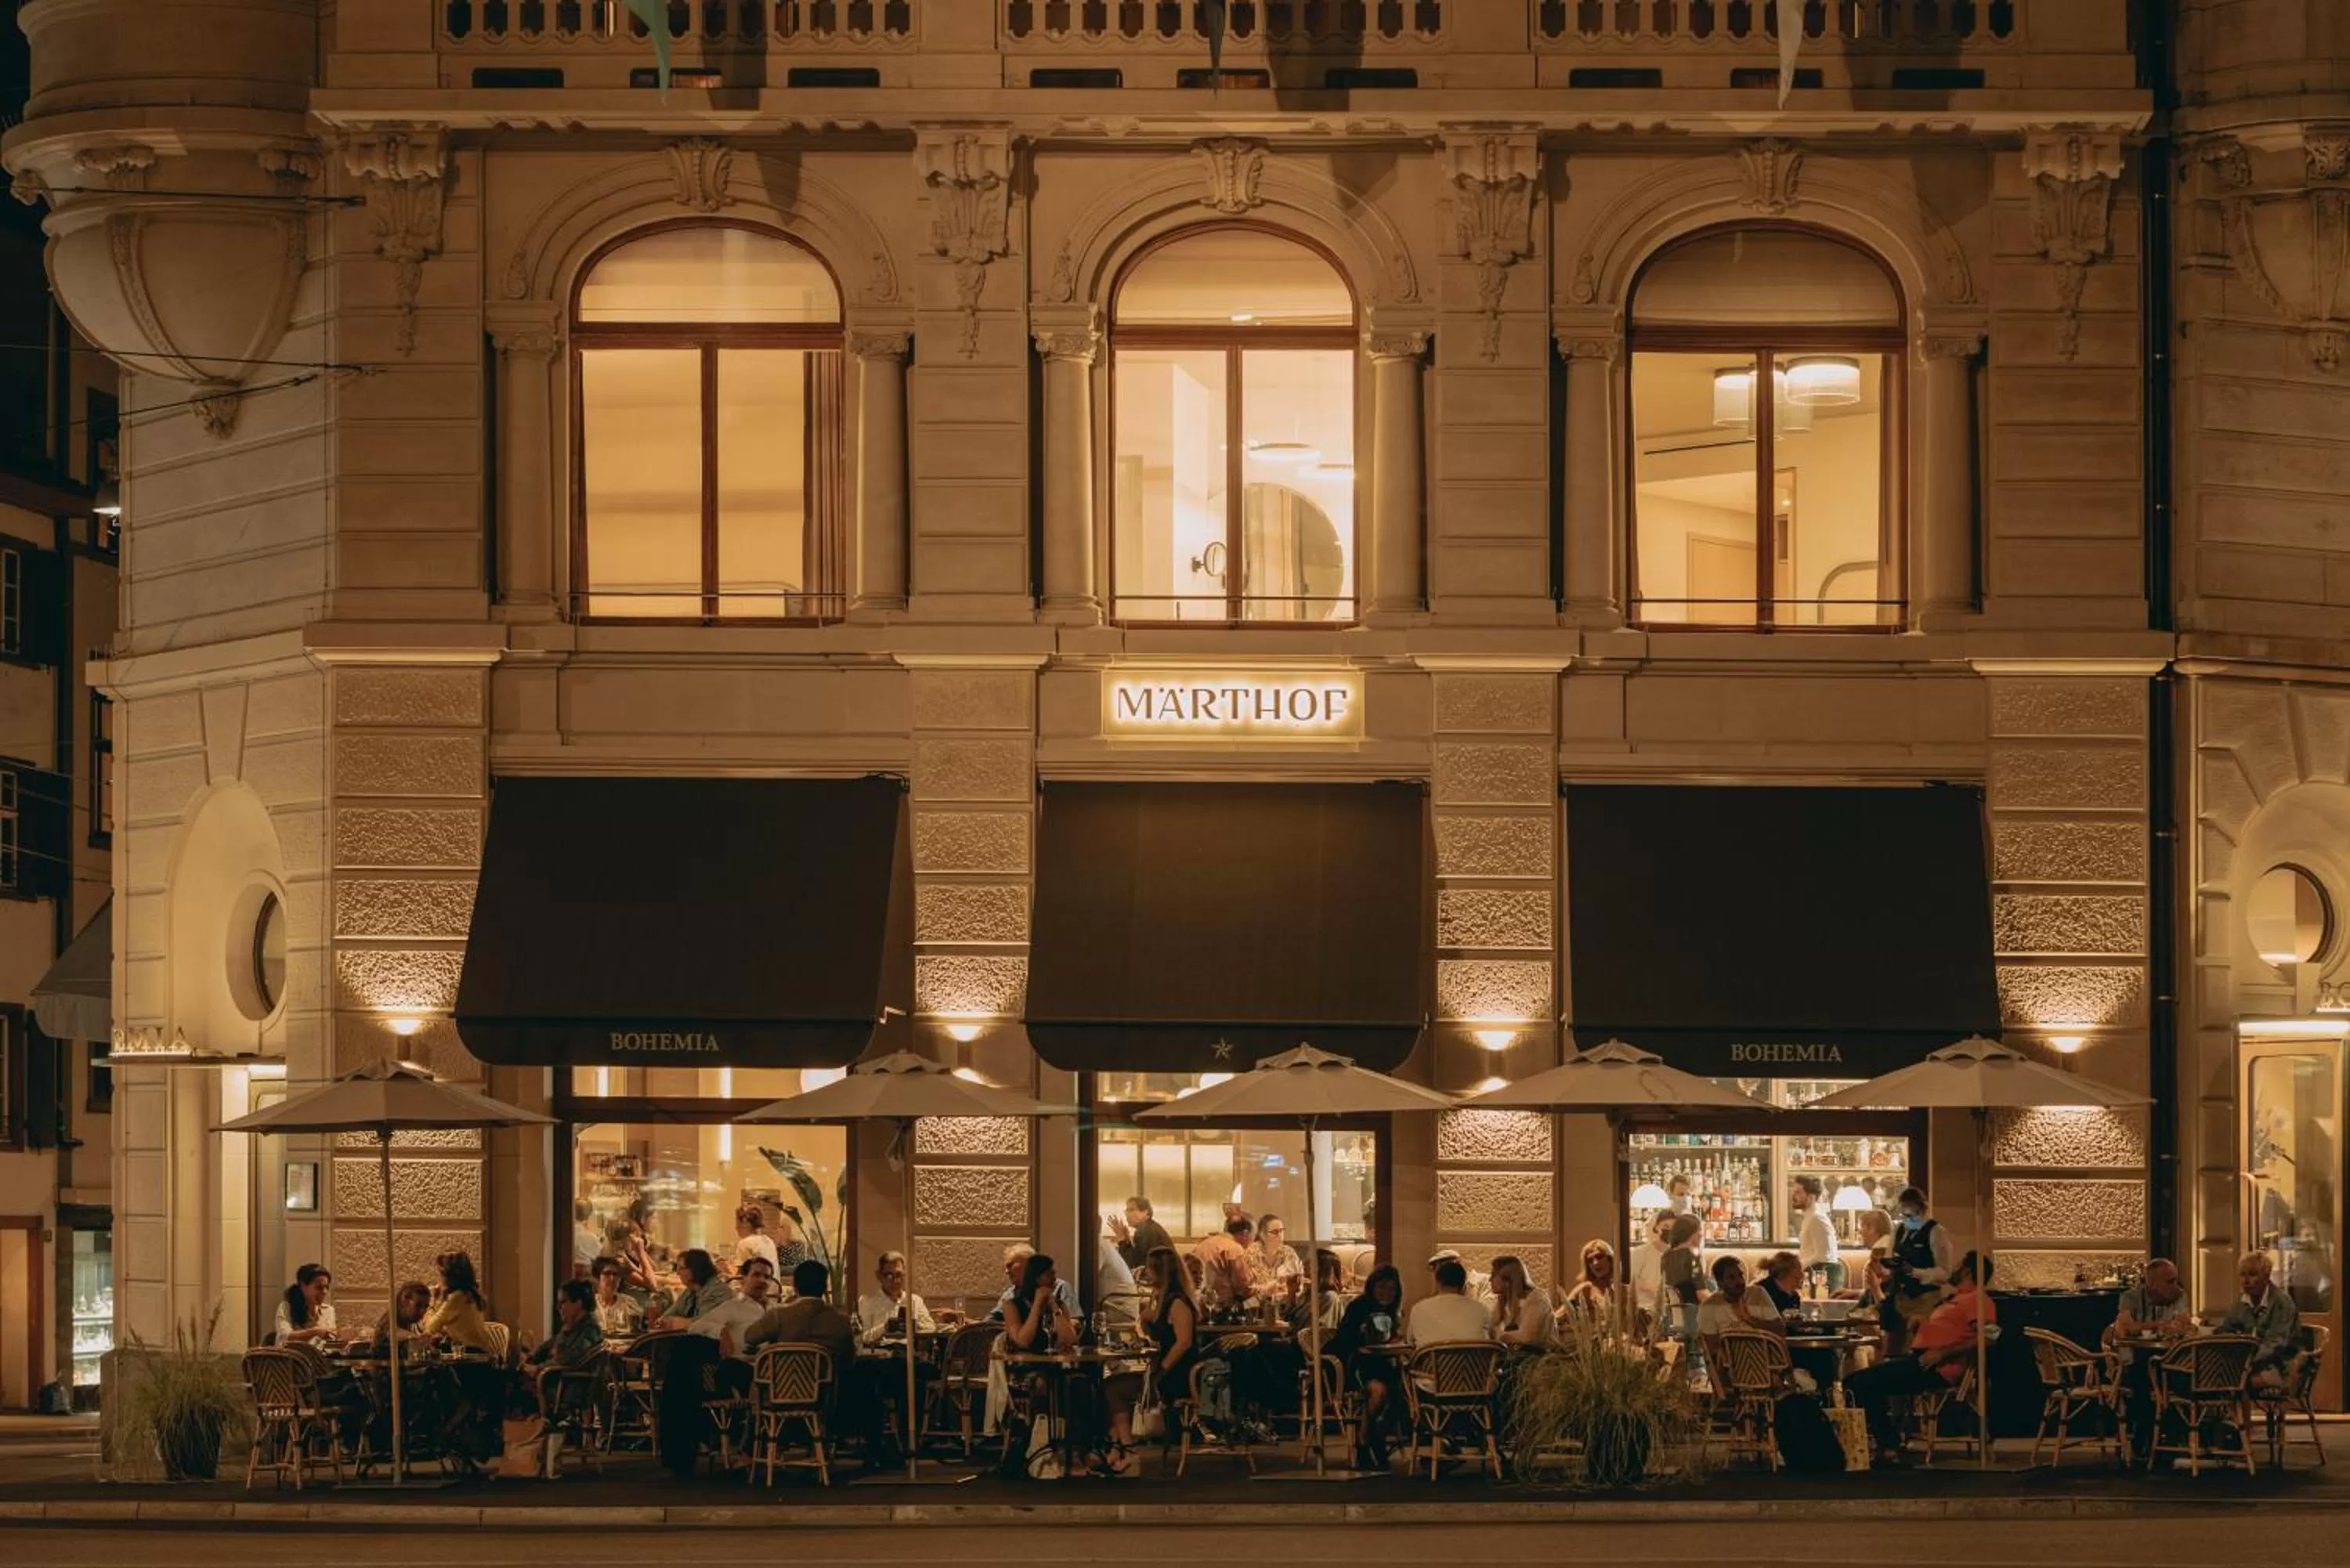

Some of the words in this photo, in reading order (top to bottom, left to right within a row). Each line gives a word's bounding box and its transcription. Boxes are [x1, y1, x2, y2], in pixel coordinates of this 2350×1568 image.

[1117, 687, 1347, 721] MÄRTHOF
[610, 1032, 720, 1051] BOHEMIA
[1730, 1043, 1842, 1063] BOHEMIA
